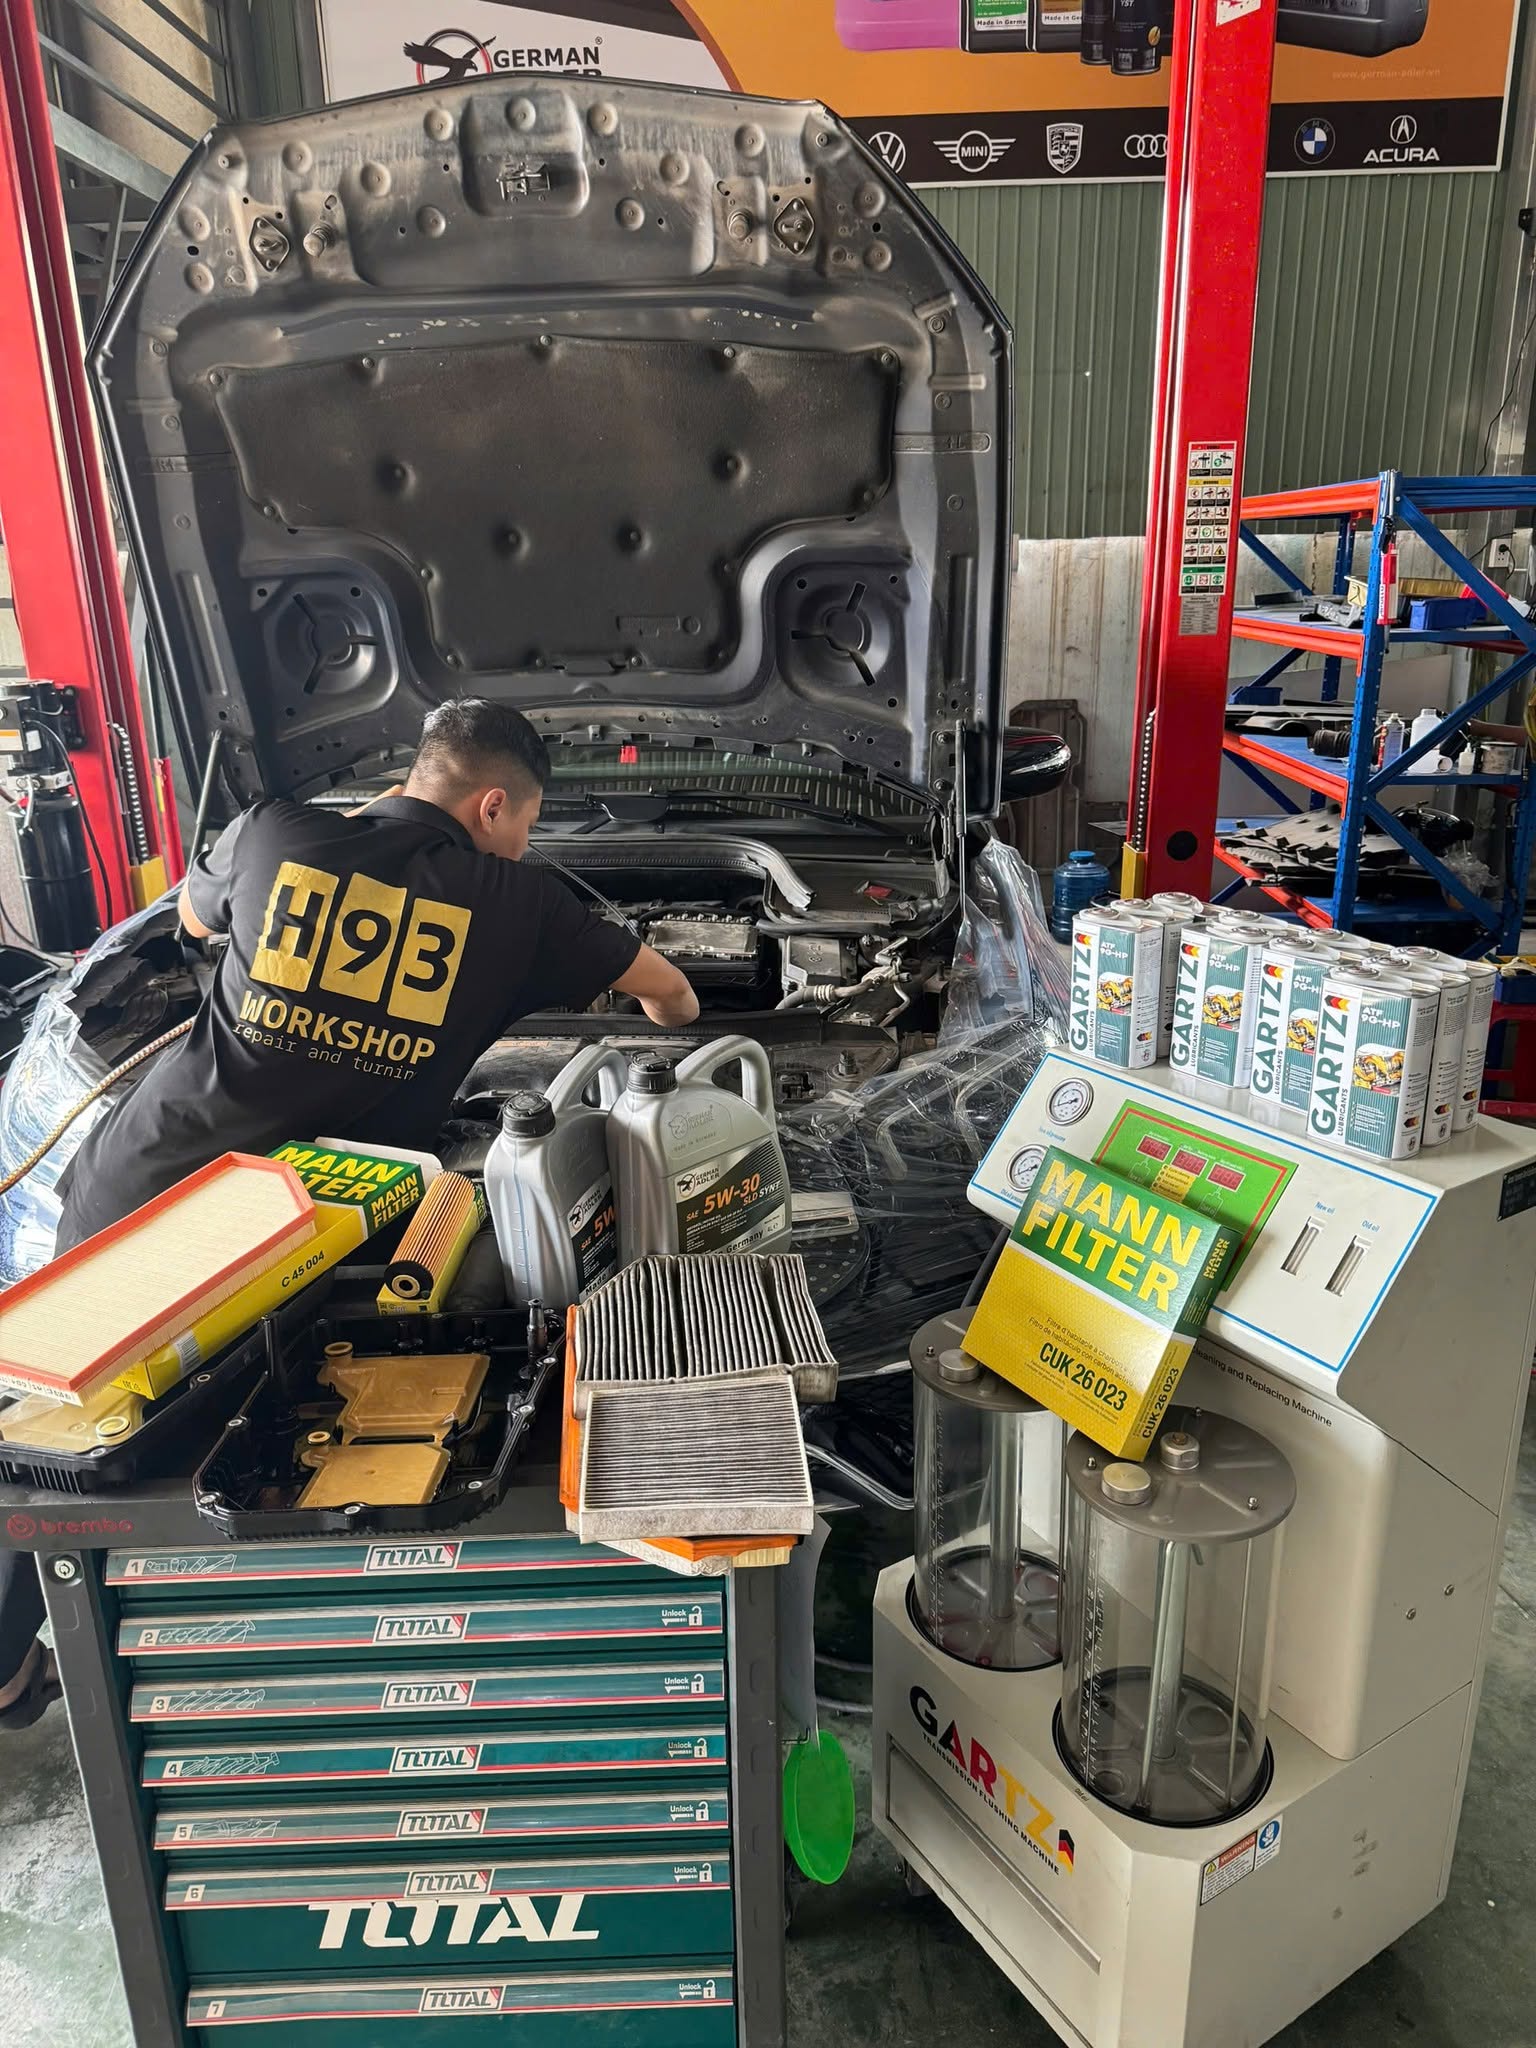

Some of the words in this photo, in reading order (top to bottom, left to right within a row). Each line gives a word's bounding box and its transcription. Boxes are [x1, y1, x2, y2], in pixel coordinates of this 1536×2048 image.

[493, 46, 600, 68] GERMAN
[961, 148, 989, 159] MINI
[1363, 148, 1440, 163] ACURA
[1101, 942, 1116, 951] ATF
[1210, 953, 1226, 966] ATF
[1293, 980, 1320, 993] 9G-H
[1295, 974, 1312, 985] ATF
[1071, 946, 1092, 1051] GARTZ
[1171, 959, 1201, 1067] GARTZ
[1363, 1006, 1384, 1017] ATF
[239, 991, 436, 1065] WORKSHOP
[1252, 976, 1284, 1094] GARTZ
[232, 1023, 299, 1053] repair
[308, 1043, 343, 1064] and
[1311, 1006, 1351, 1136] GARTZ
[1337, 1087, 1350, 1137] LUBRICANTS
[270, 1146, 404, 1183] MANN
[695, 1168, 720, 1181] GERMAN
[696, 1173, 720, 1187] ADLER
[370, 1172, 418, 1216] MANN
[686, 1210, 699, 1222] SAE
[703, 1173, 761, 1215] 5W-30
[372, 1192, 421, 1229] FILTER
[1040, 1159, 1202, 1267] MANN
[727, 1229, 764, 1252] Germany
[1022, 1200, 1180, 1313] FILTER
[1202, 1238, 1225, 1278] MANN
[1208, 1240, 1231, 1280] FILTER
[281, 1276, 291, 1288] C
[292, 1265, 305, 1280] 45
[305, 1250, 325, 1270] 004
[1040, 1342, 1075, 1378] CUK
[1071, 1363, 1096, 1390] 26
[1094, 1377, 1128, 1411] 023
[1192, 1346, 1228, 1372] leaning
[1227, 1366, 1245, 1380] and
[1245, 1375, 1292, 1406] Replacing
[1291, 1400, 1332, 1427] Machine
[1142, 1411, 1161, 1439] CUK
[1154, 1394, 1168, 1411] 26
[1162, 1368, 1179, 1393] 023
[42, 1518, 134, 1538] brembo
[375, 1545, 447, 1568] TOTAL
[131, 1560, 140, 1576] 1
[662, 1608, 687, 1618] Unlock
[383, 1614, 455, 1638] TOTAL
[143, 1630, 154, 1647] 2
[663, 1676, 689, 1686] Unlock
[156, 1696, 166, 1712] 3
[392, 1683, 462, 1705] TOTAL
[667, 1741, 692, 1750] Unlock
[400, 1748, 469, 1769] TOTAL
[168, 1763, 178, 1777] 4
[909, 1685, 1056, 1858] GARTZ
[669, 1804, 694, 1815] Unlock
[922, 1731, 979, 1793] TRANSMISSION
[978, 1788, 1019, 1834] FLUSHING
[1020, 1831, 1060, 1876] MACHINE
[178, 1825, 188, 1840] 5
[407, 1812, 474, 1834] TOTAL
[674, 1865, 698, 1875] Unlock
[416, 1871, 482, 1894] TOTAL
[190, 1888, 200, 1902] 6
[308, 1893, 600, 1949] TOTAL
[678, 1982, 702, 1993] Unlock
[212, 2001, 221, 2016] 7
[428, 1989, 493, 2011] TOTAL
